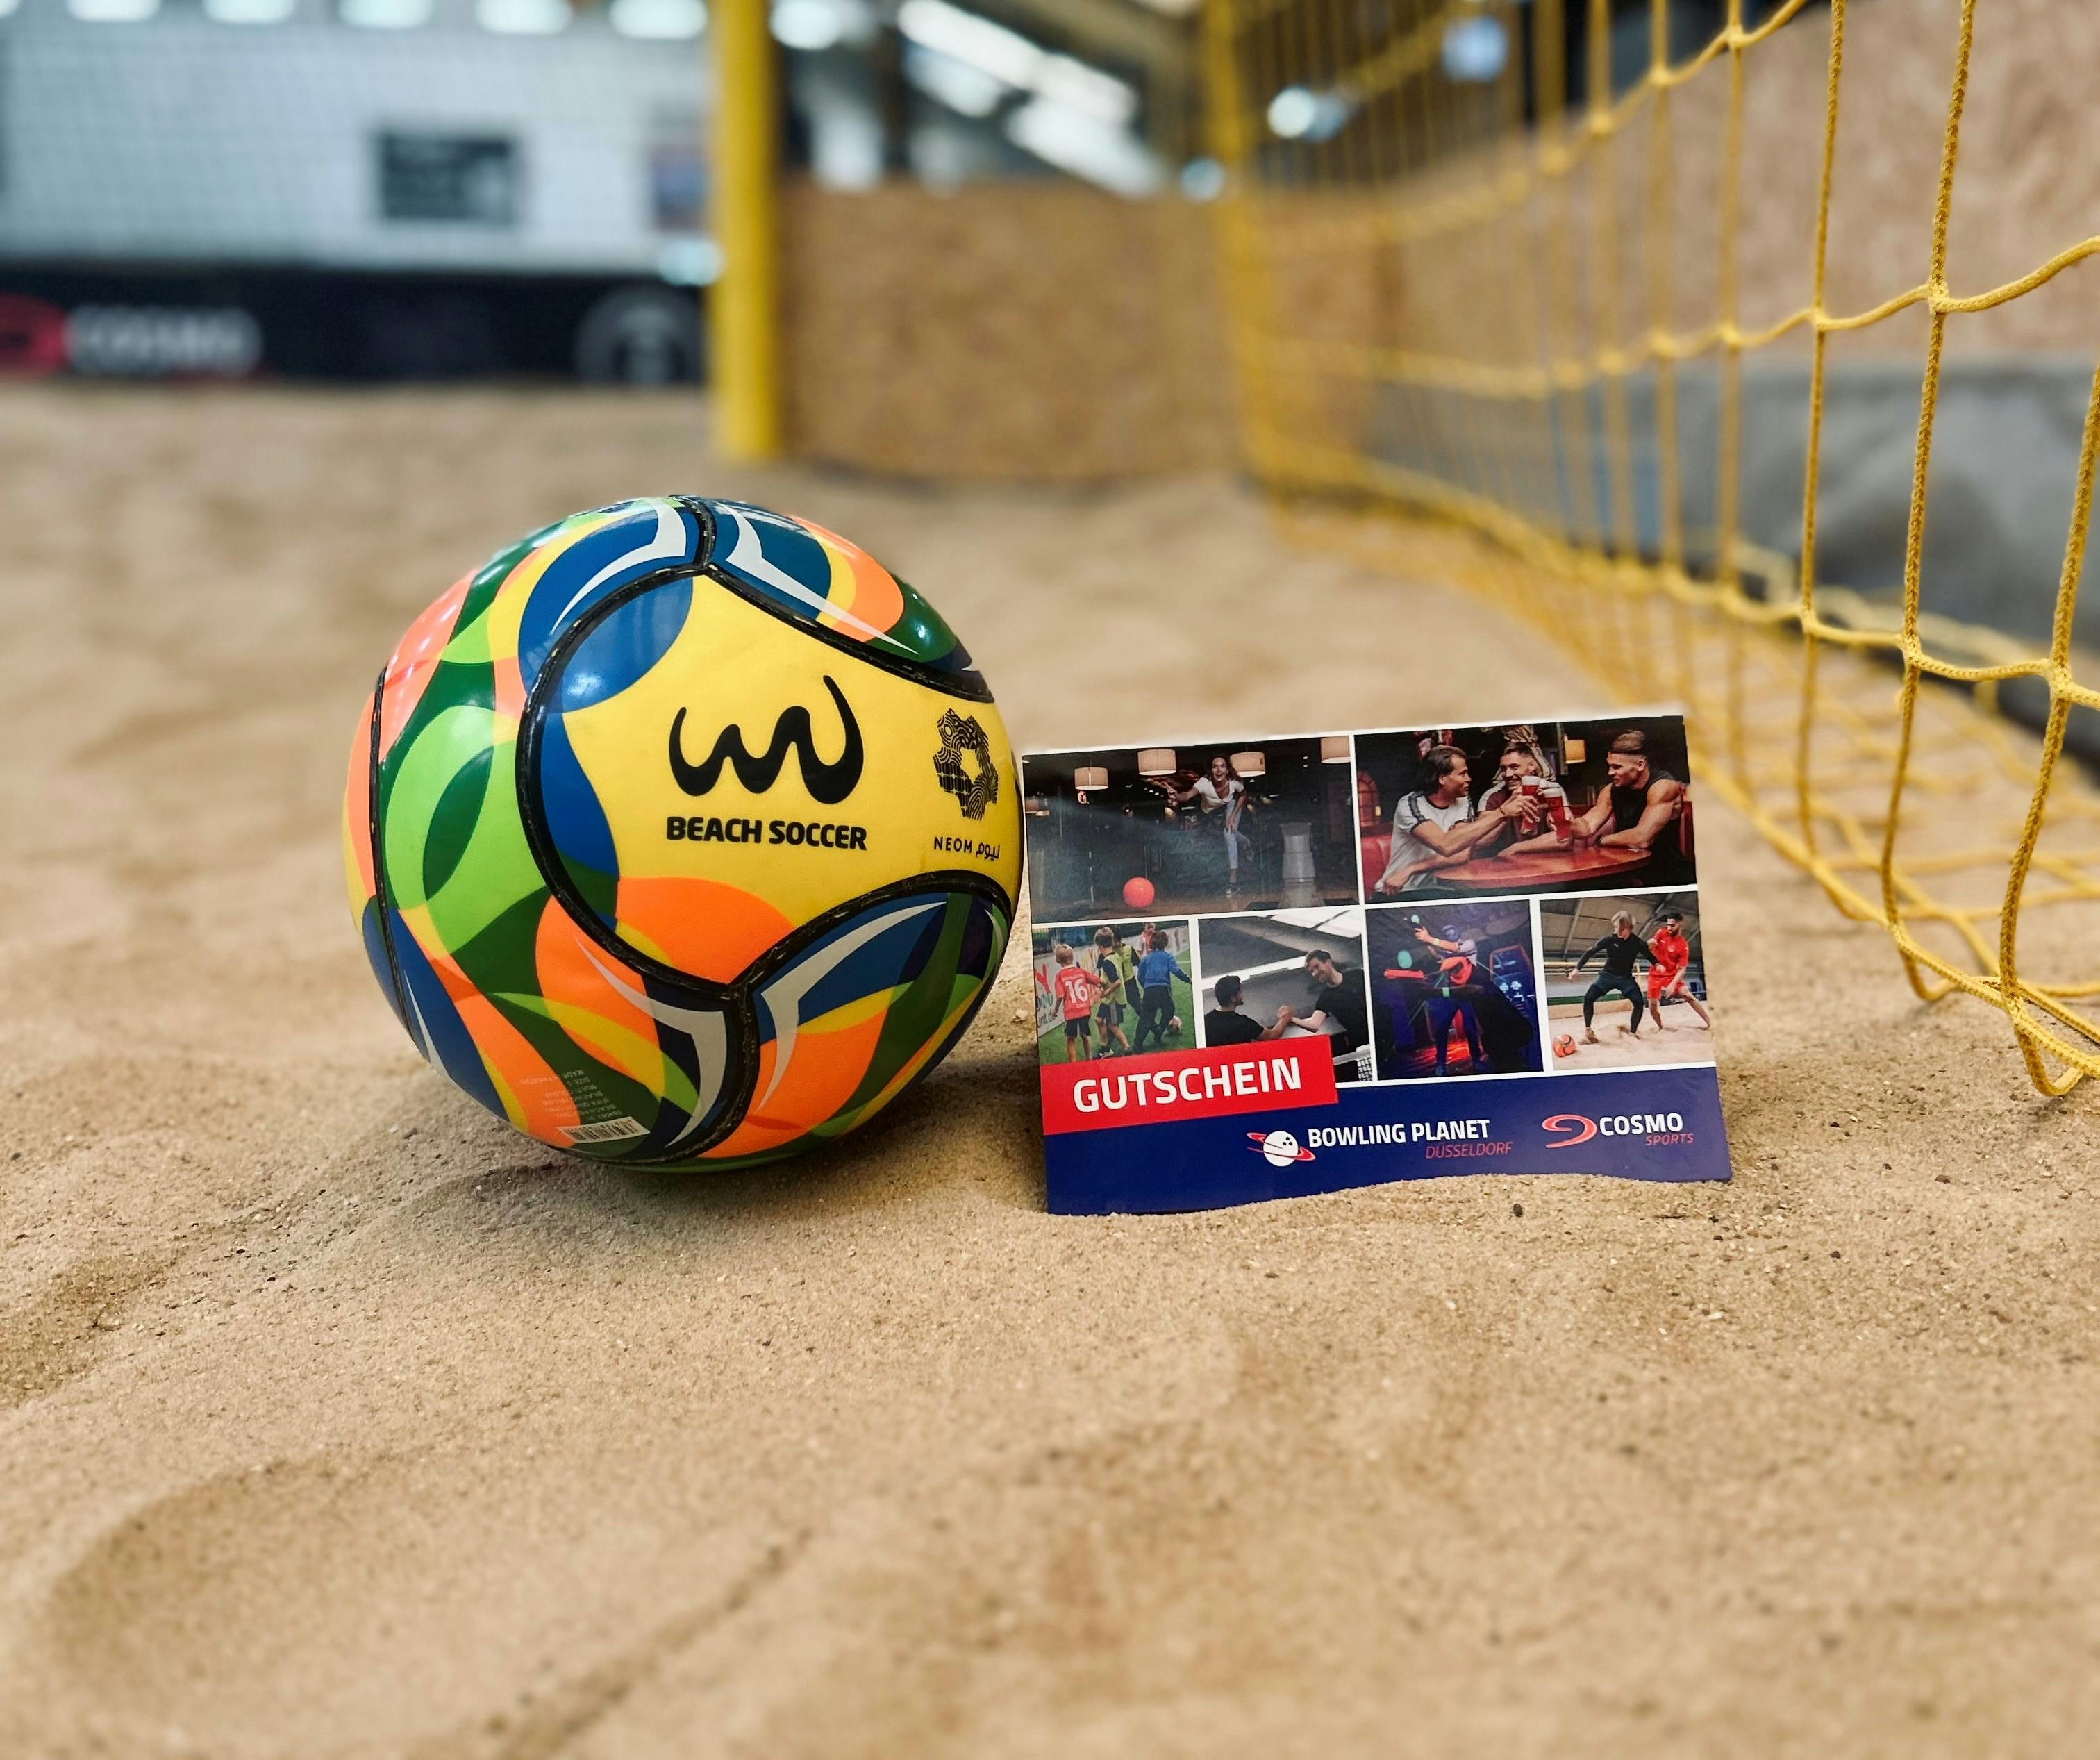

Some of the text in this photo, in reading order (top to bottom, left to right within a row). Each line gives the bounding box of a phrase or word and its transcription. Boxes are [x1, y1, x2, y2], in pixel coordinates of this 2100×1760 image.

[666, 815, 867, 851] BEACH SOCCER
[933, 836, 973, 854] NEOM
[1065, 977, 1089, 1004] 16
[1074, 1056, 1301, 1113] GUTSCHEIN
[1308, 1119, 1490, 1148] BOWLING PLANET
[1599, 1113, 1684, 1137] COSMO
[1645, 1133, 1694, 1147] SPORTS
